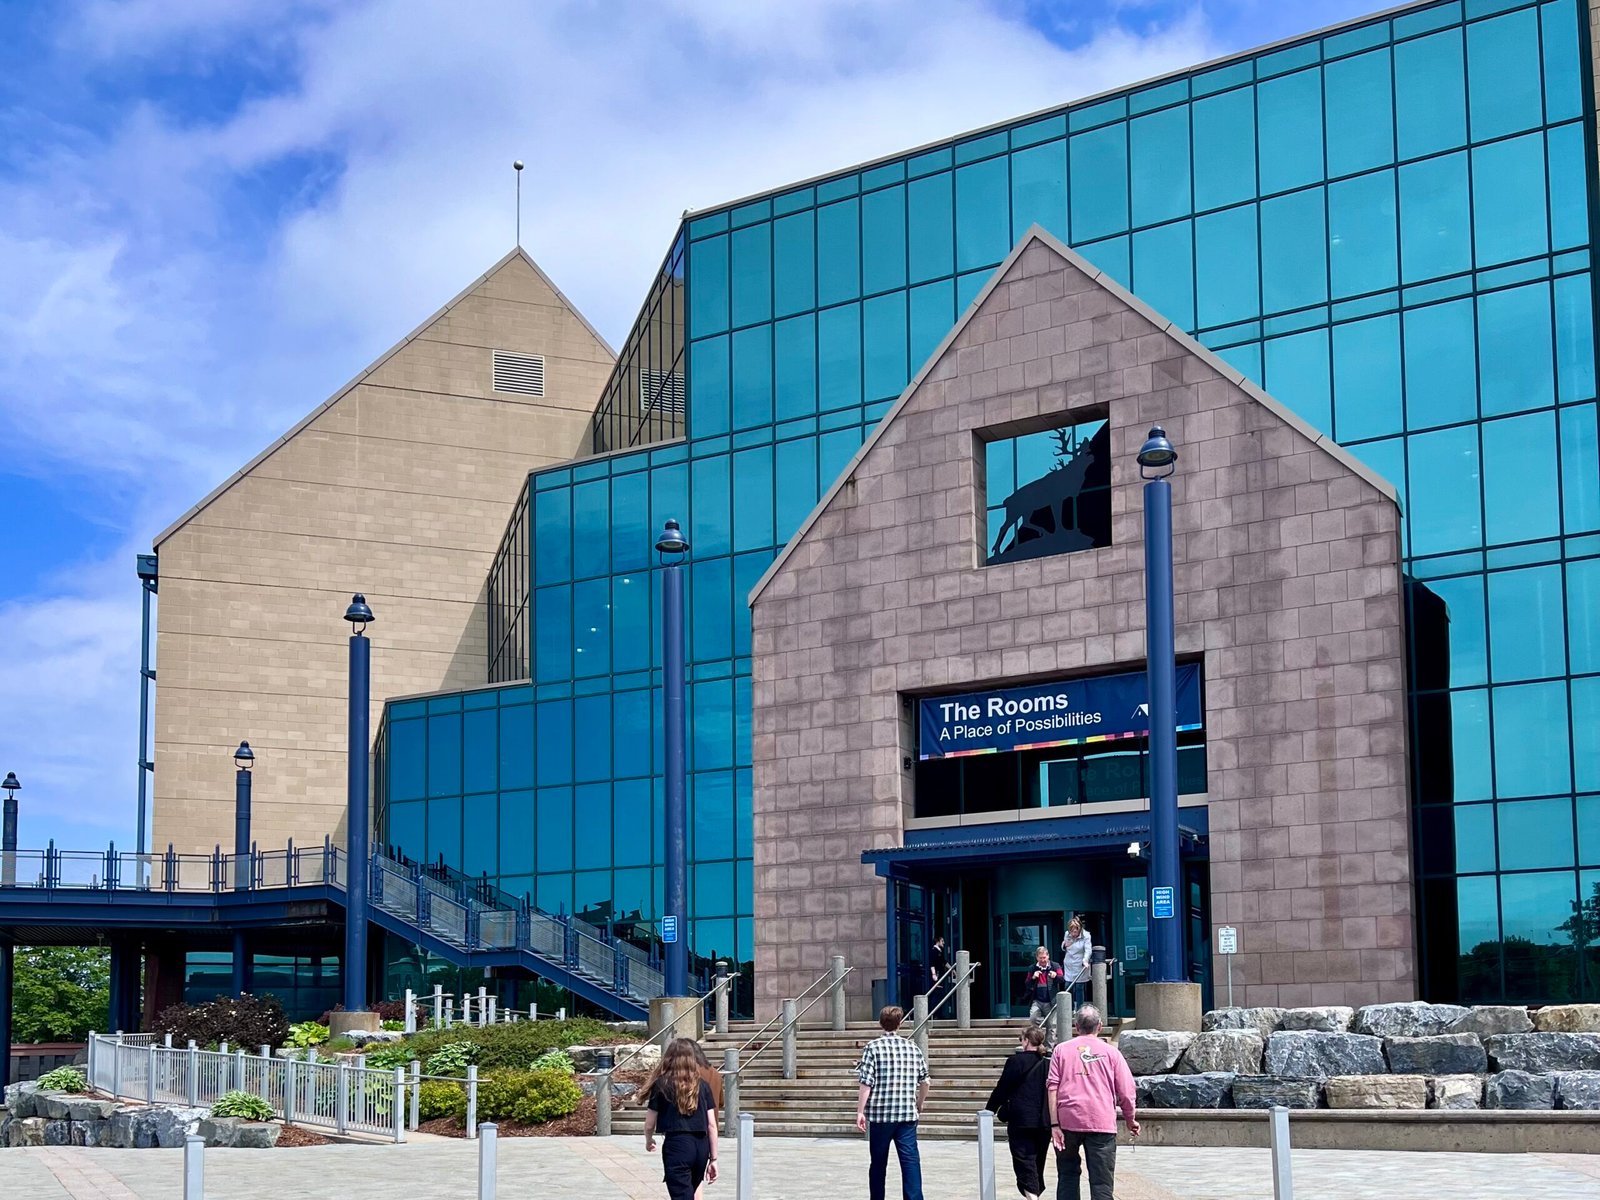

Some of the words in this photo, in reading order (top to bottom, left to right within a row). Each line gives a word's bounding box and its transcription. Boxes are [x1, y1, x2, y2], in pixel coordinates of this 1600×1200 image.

[940, 702, 981, 723] The
[987, 693, 1069, 718] Rooms
[940, 727, 951, 741] A
[954, 725, 993, 740] Place
[997, 720, 1012, 735] of
[1015, 711, 1102, 733] Possibilities
[1126, 899, 1148, 908] Ente
